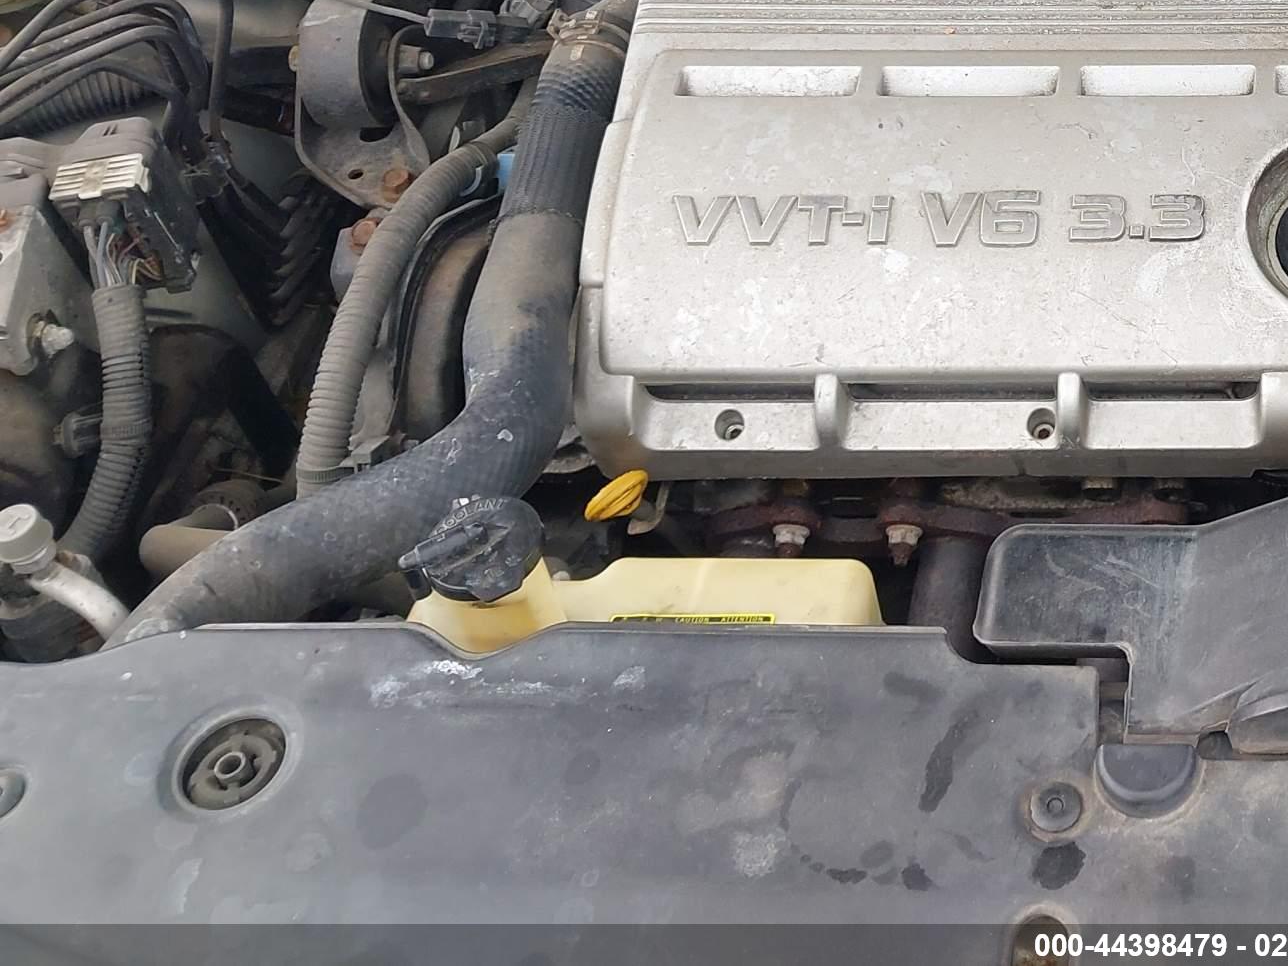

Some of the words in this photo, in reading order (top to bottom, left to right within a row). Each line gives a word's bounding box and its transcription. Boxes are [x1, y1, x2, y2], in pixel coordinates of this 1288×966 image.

[673, 195, 894, 246] VVT-i
[920, 190, 1042, 247] V6
[1068, 194, 1206, 242] 3.3
